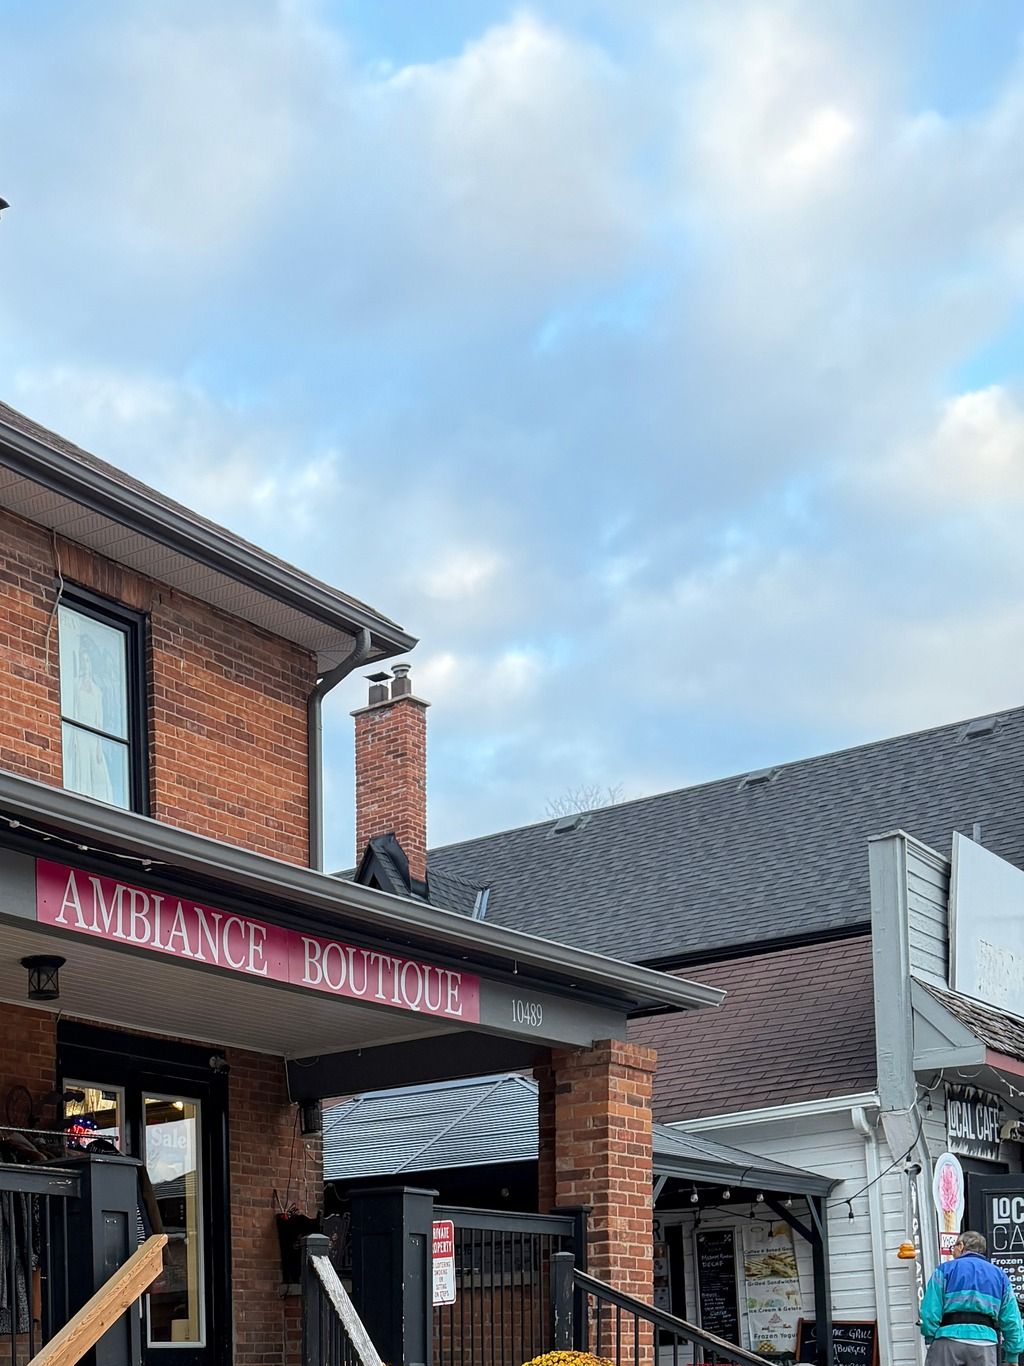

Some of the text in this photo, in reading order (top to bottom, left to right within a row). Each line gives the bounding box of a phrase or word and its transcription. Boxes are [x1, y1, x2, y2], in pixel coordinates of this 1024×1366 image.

[55, 870, 462, 1016] AMBIANCE BOUTIQUE
[512, 999, 543, 1027] 10489
[947, 1099, 975, 1140] LOCAL
[150, 1127, 187, 1149] Sale
[992, 1196, 1024, 1225] LOC
[433, 1227, 449, 1239] RIVATE
[848, 1328, 872, 1339] GRILL
